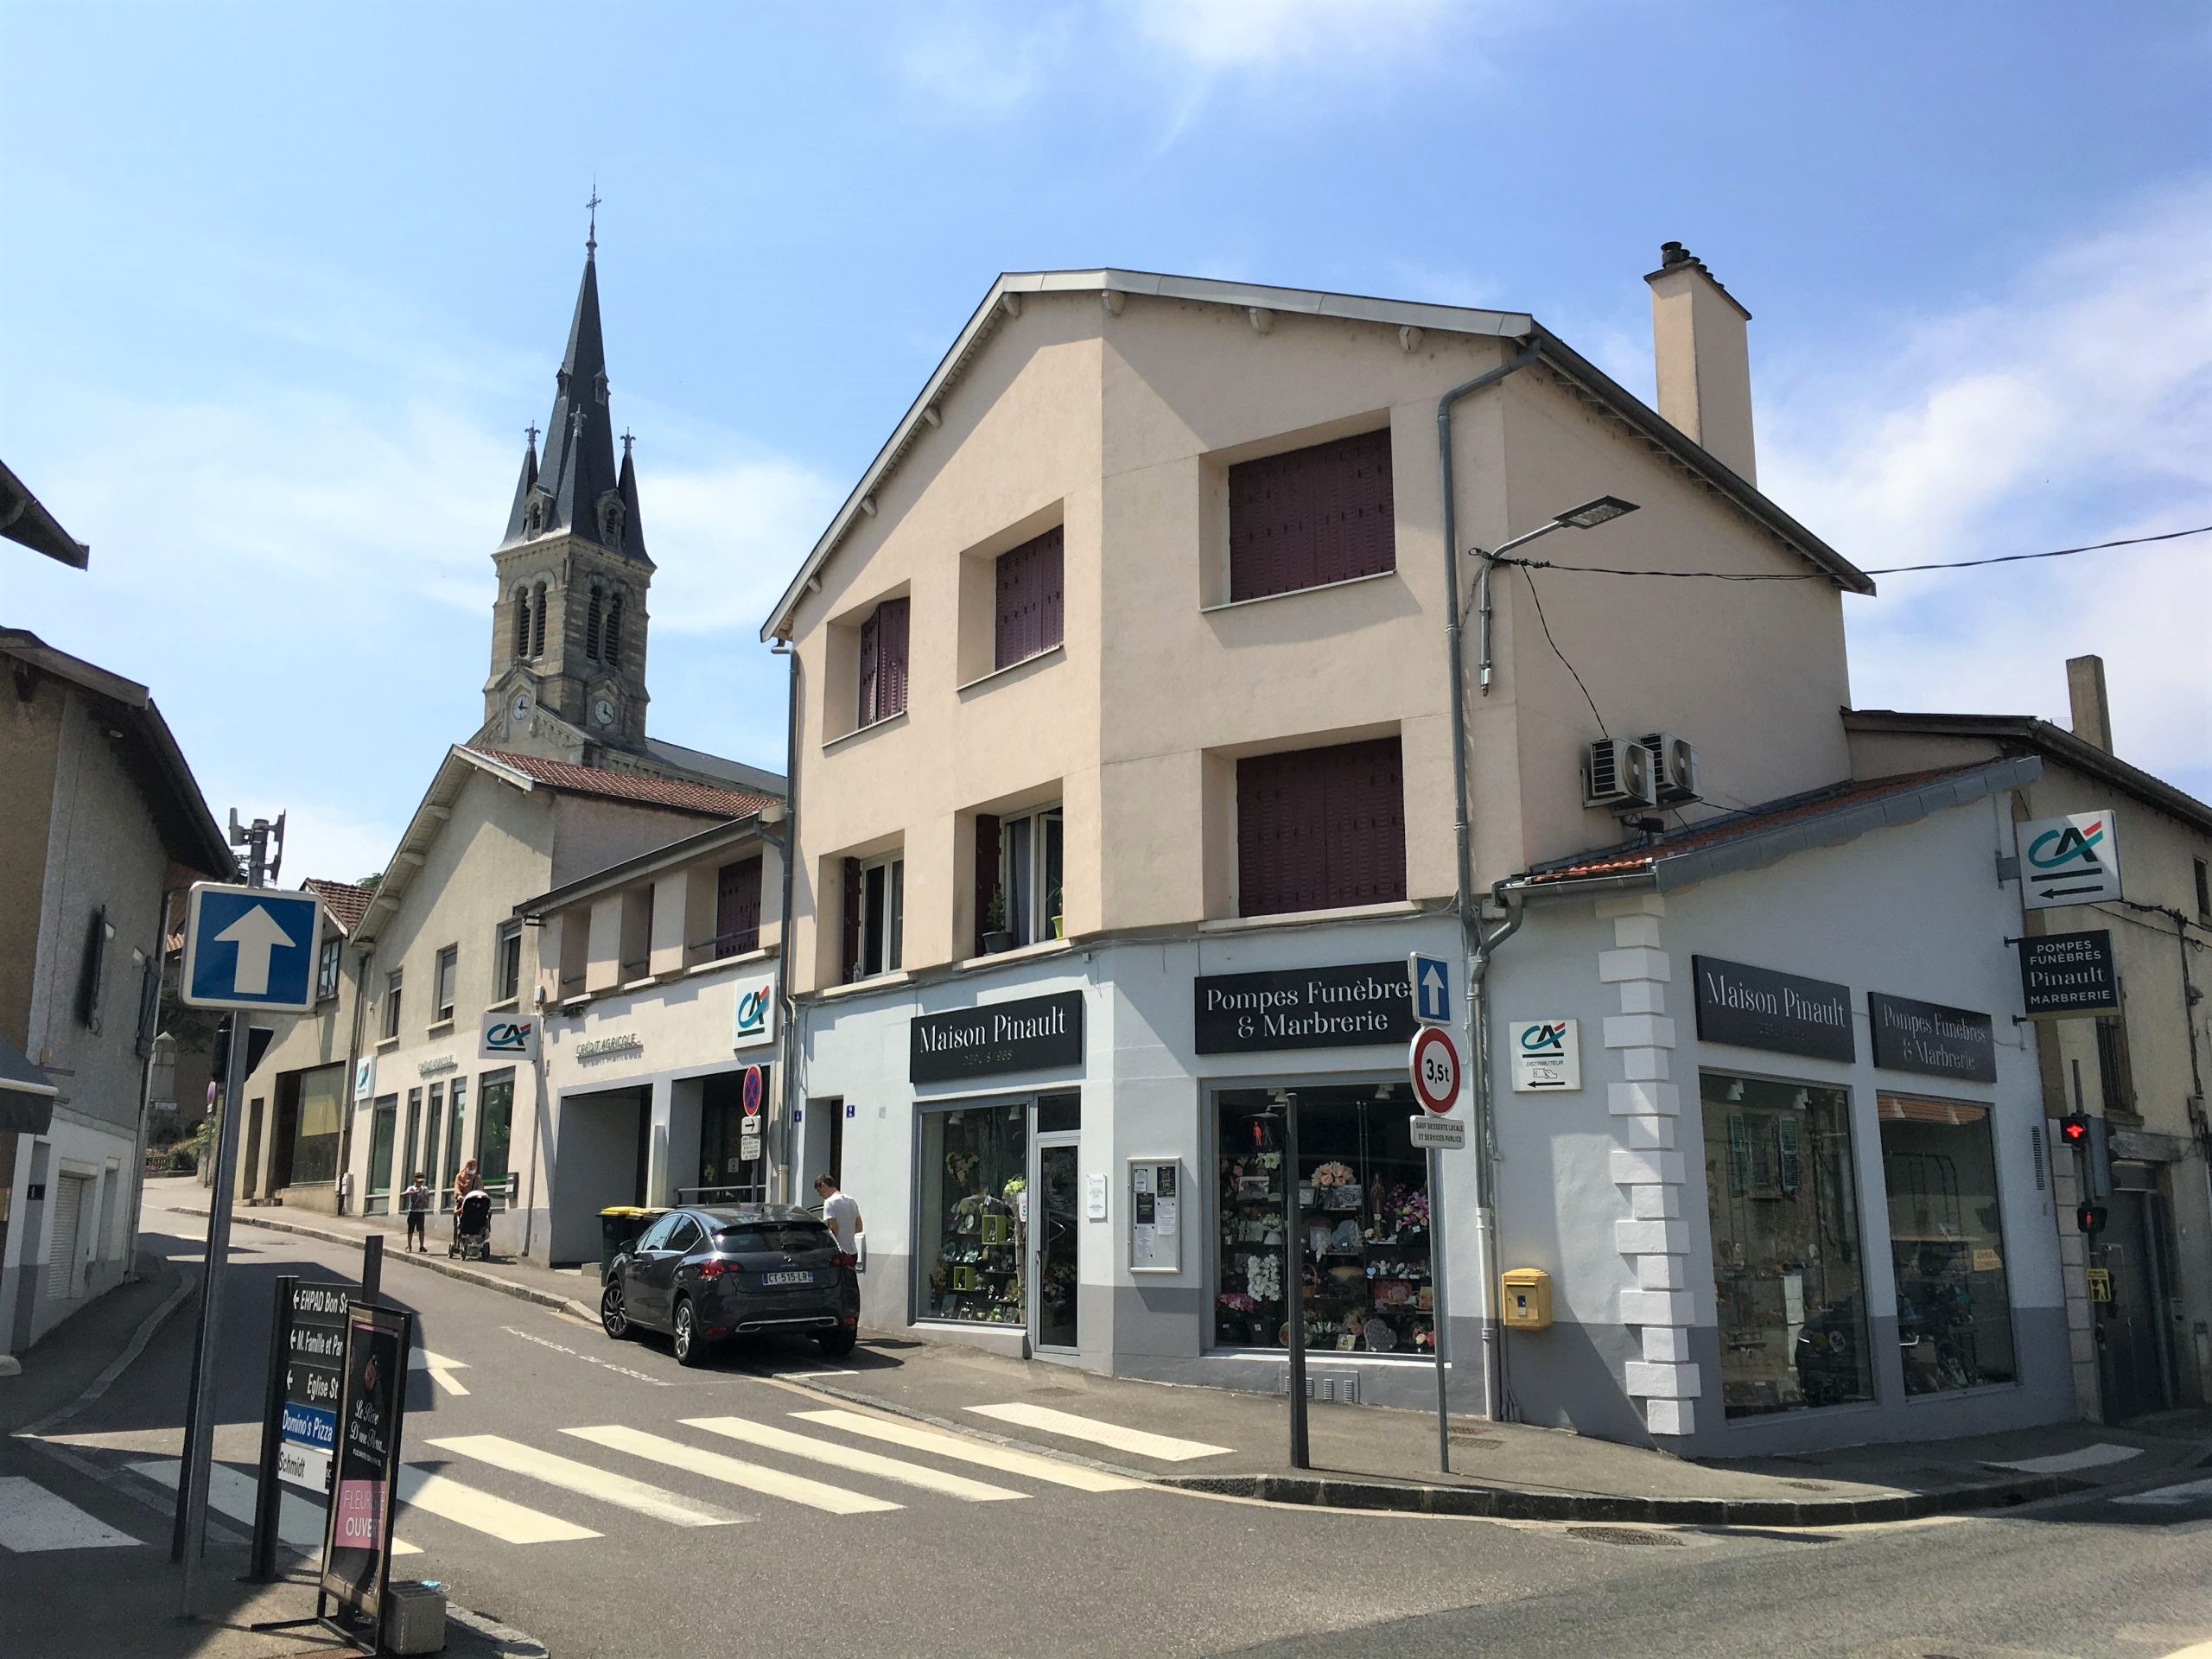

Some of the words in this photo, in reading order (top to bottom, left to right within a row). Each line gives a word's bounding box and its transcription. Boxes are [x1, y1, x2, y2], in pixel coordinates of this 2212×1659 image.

[2028, 820, 2103, 868] CA
[2030, 950, 2101, 965] FUNÈBRES
[2037, 940, 2092, 954] POMPES
[2031, 966, 2107, 987] Pinault
[738, 985, 770, 1028] CA
[1207, 988, 1298, 1014] Pompes
[1707, 972, 1777, 1015] Maison
[1783, 987, 1847, 1028] Pinault
[2030, 989, 2111, 1005] MARBRERIE
[486, 1023, 531, 1046] CA
[920, 1025, 986, 1052] Maison
[995, 1006, 1067, 1042] Pinault
[1237, 1015, 1255, 1039] &
[1264, 1011, 1389, 1037] Marbrerie
[1521, 1022, 1566, 1050] CA
[1883, 1002, 1932, 1039] Pompes
[1935, 1013, 1986, 1044] Funèbres
[601, 1033, 637, 1050] AGRICOLE
[1916, 1039, 1976, 1071] Marbrerie
[1427, 1122, 1448, 1131] DESSERTE
[768, 1272, 808, 1283] CT-515-LR
[300, 1289, 324, 1311] EHPAD
[324, 1292, 338, 1313] Bon
[296, 1330, 304, 1351] M.
[305, 1331, 324, 1354] Famille
[325, 1337, 332, 1355] et
[332, 1334, 343, 1357] Par
[307, 1374, 327, 1400] Eglise
[329, 1377, 338, 1399] St
[355, 1400, 364, 1420] Le
[282, 1409, 311, 1436] Domino's
[312, 1417, 333, 1442] Pizza
[278, 1452, 305, 1478] Schmidt
[346, 1516, 381, 1538] OUVERT
